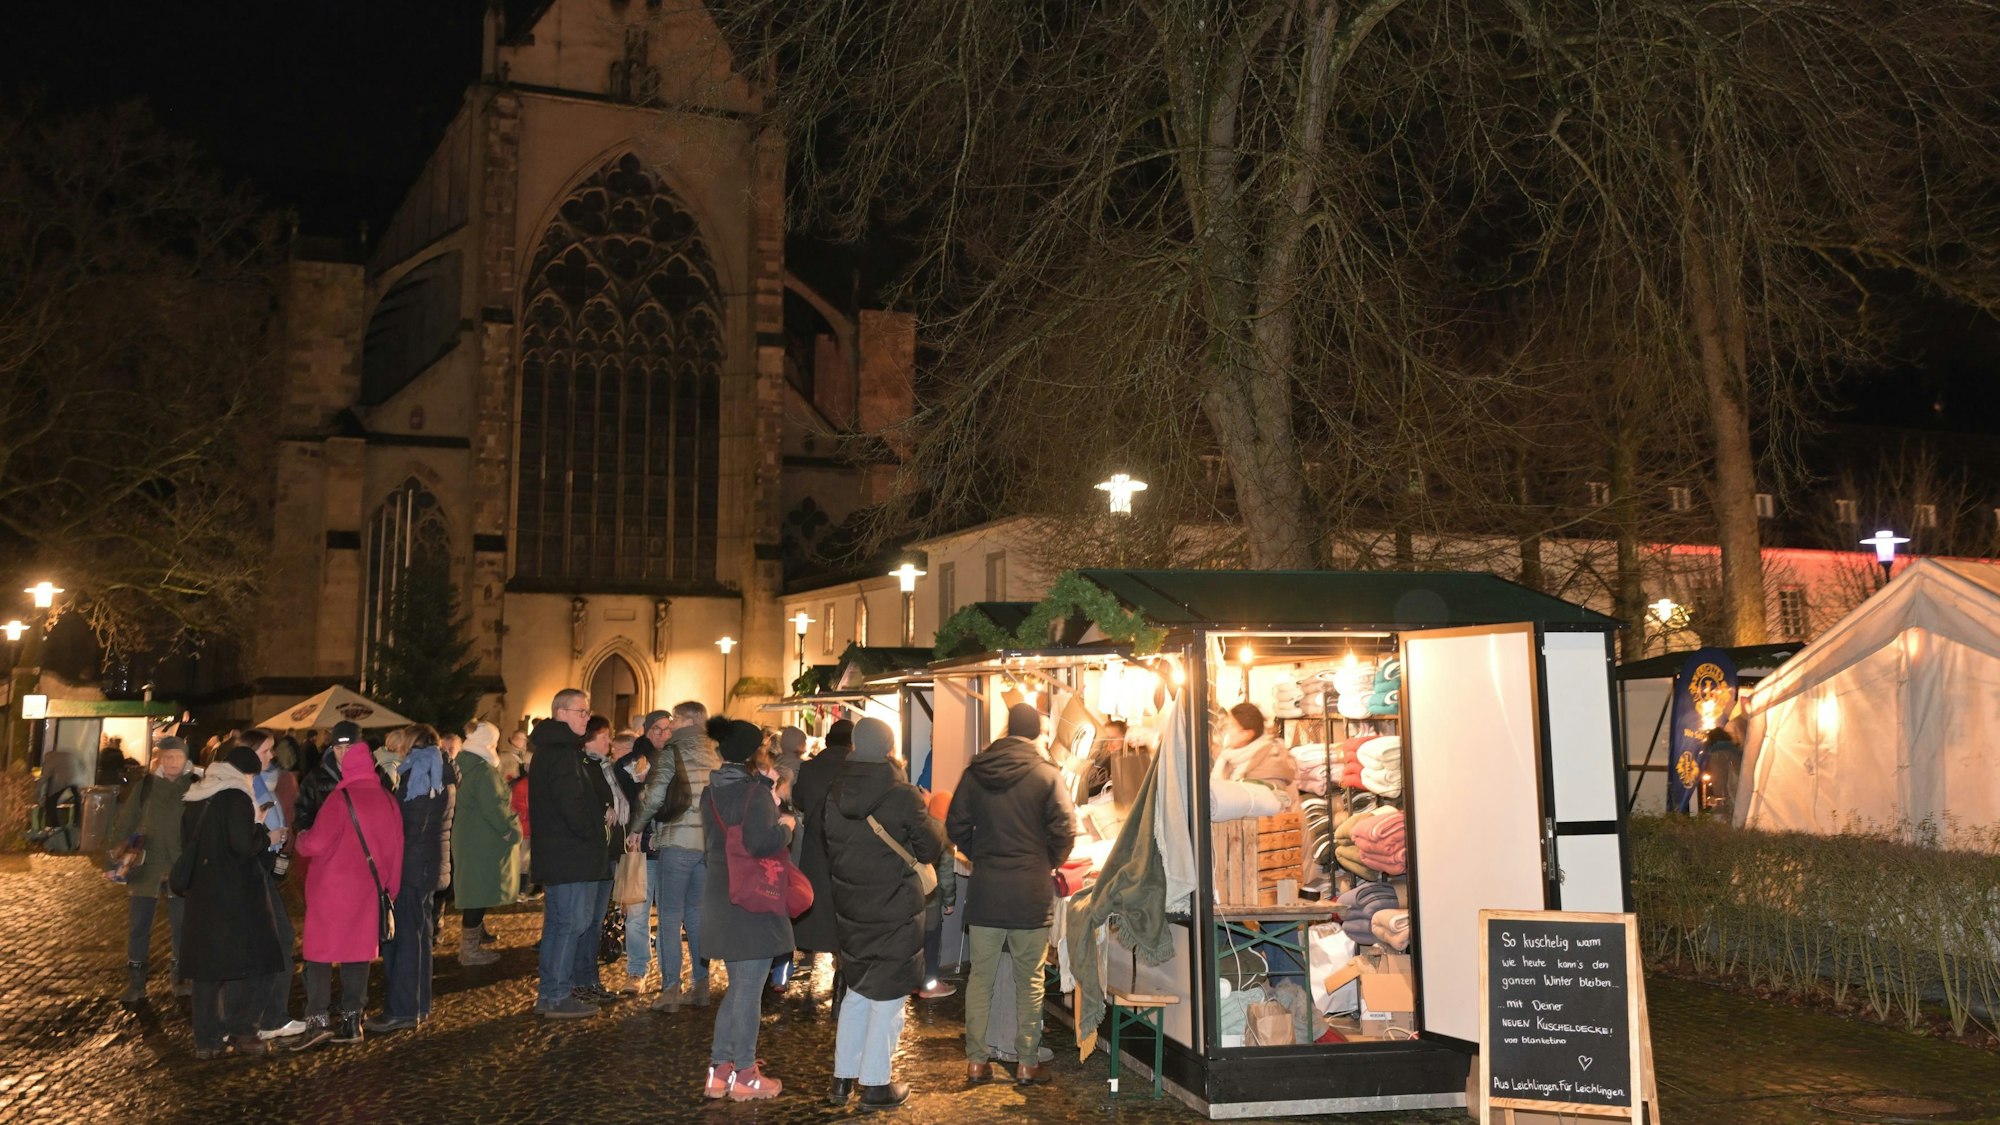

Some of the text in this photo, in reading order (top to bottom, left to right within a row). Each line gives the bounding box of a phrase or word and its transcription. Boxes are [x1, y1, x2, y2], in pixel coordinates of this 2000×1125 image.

[1501, 932, 1602, 952] So kuschelig warm
[1501, 958, 1517, 968] wie
[1522, 955, 1547, 968] heute
[1591, 960, 1609, 970] den
[1501, 977, 1536, 990] ganzen
[1543, 974, 1574, 987] Winter
[1531, 1000, 1564, 1012] Deiner
[1501, 1018, 1531, 1028] NEUEN
[1503, 1036, 1519, 1044] von
[1493, 1076, 1510, 1090] Aus
[1559, 1080, 1573, 1092] Für
